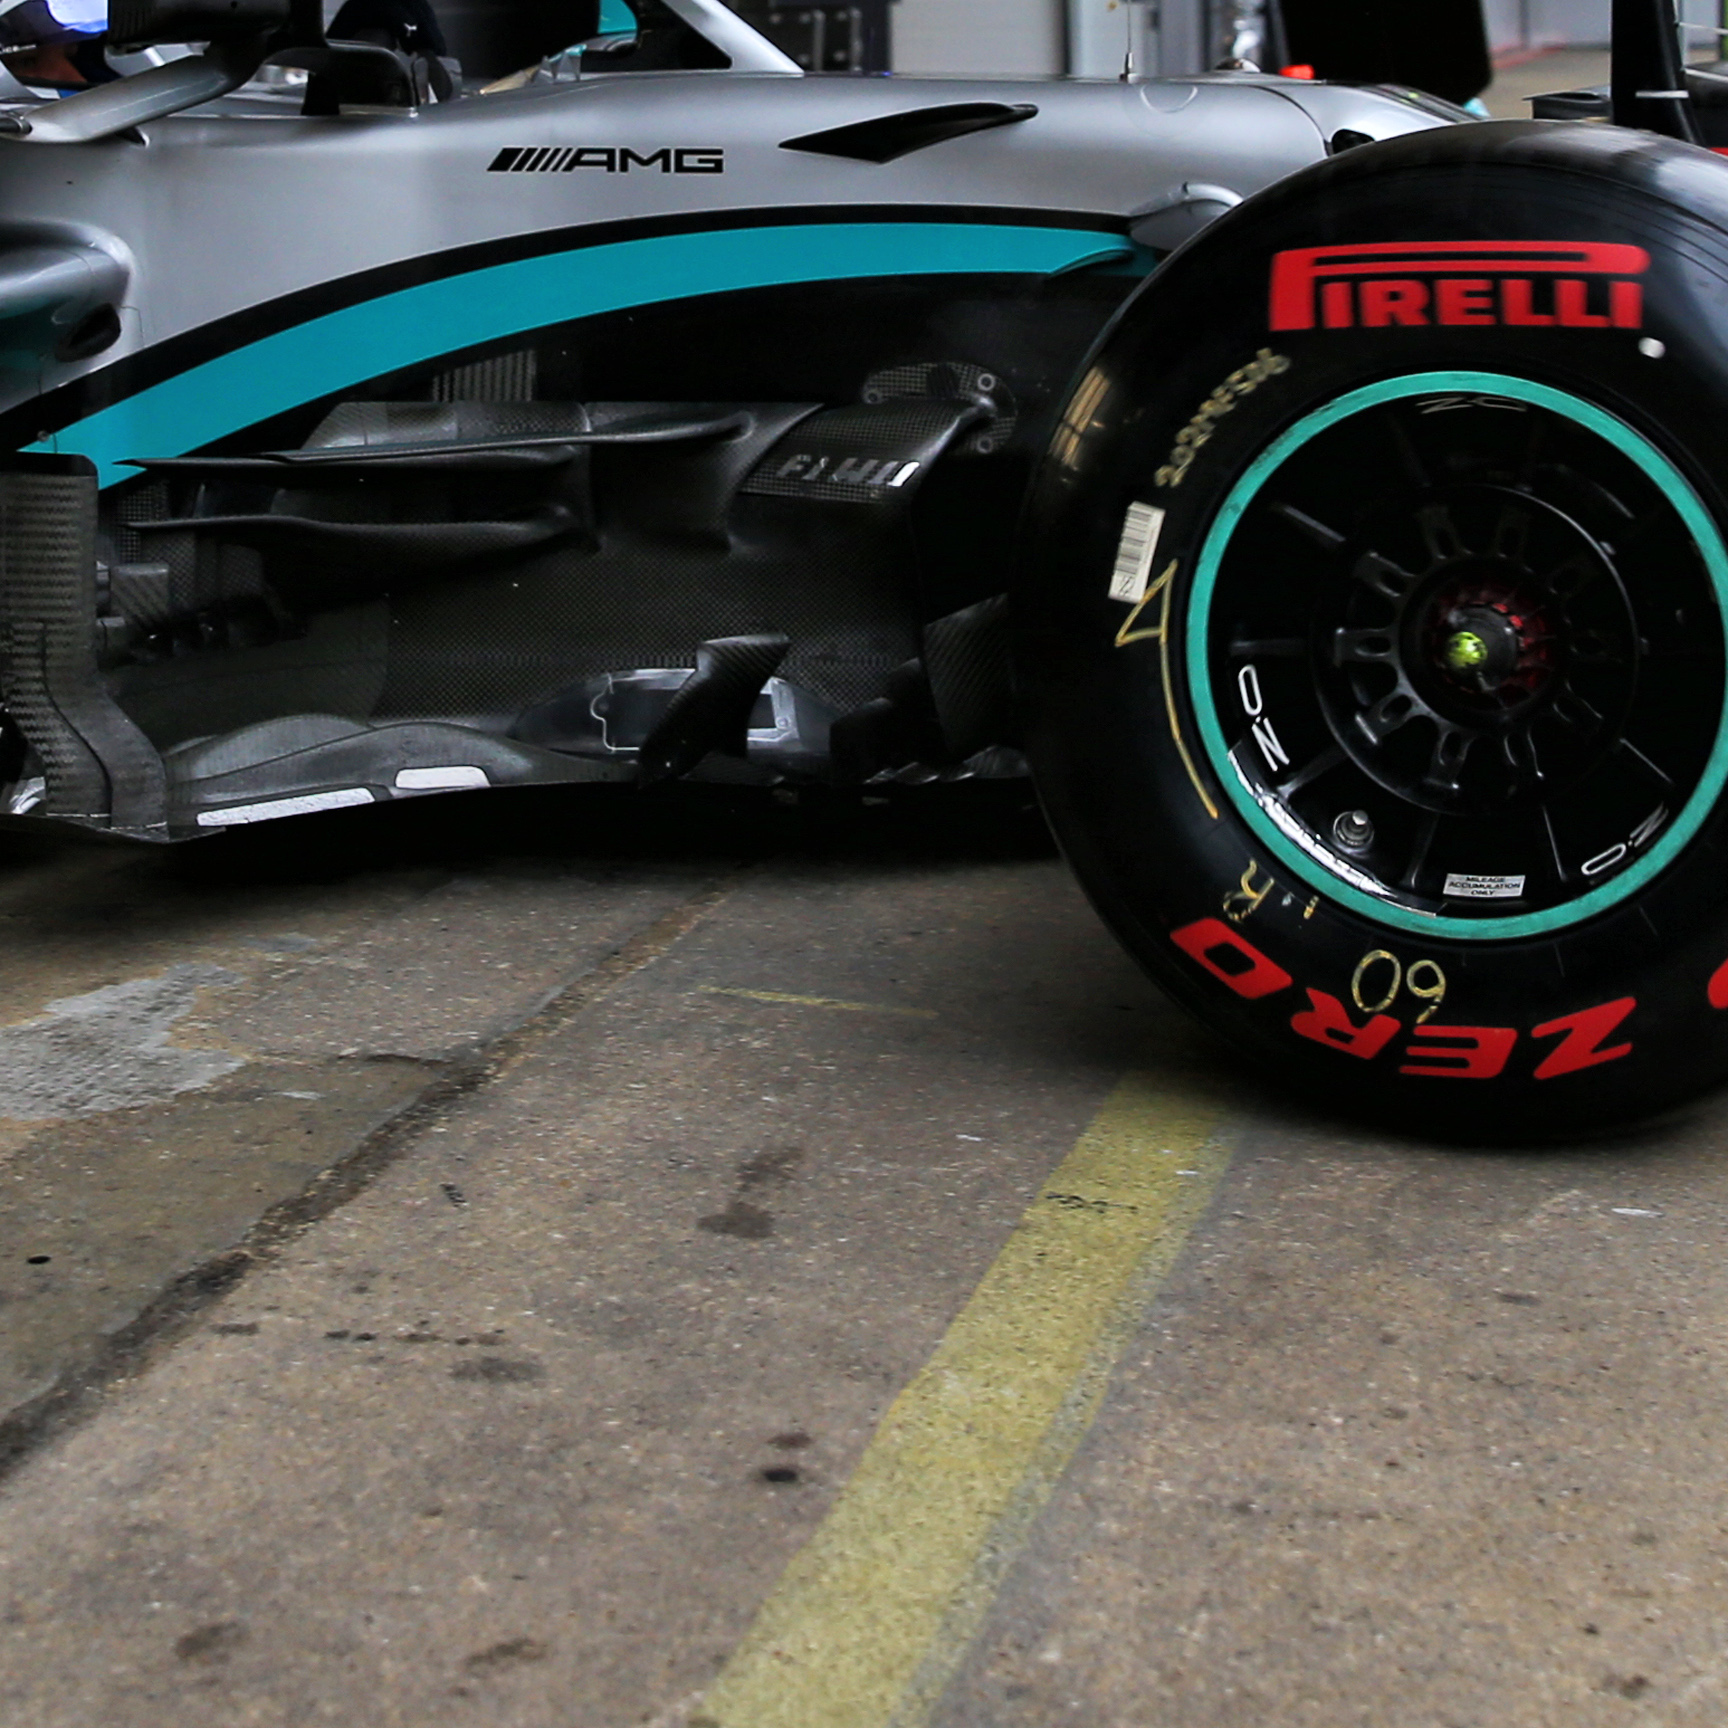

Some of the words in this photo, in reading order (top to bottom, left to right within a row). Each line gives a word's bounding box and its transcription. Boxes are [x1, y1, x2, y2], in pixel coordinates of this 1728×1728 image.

[1271, 240, 1651, 332] PIRELLI
[1448, 881, 1520, 890] ACCUMULATION
[1169, 917, 1637, 1080] ZERO
